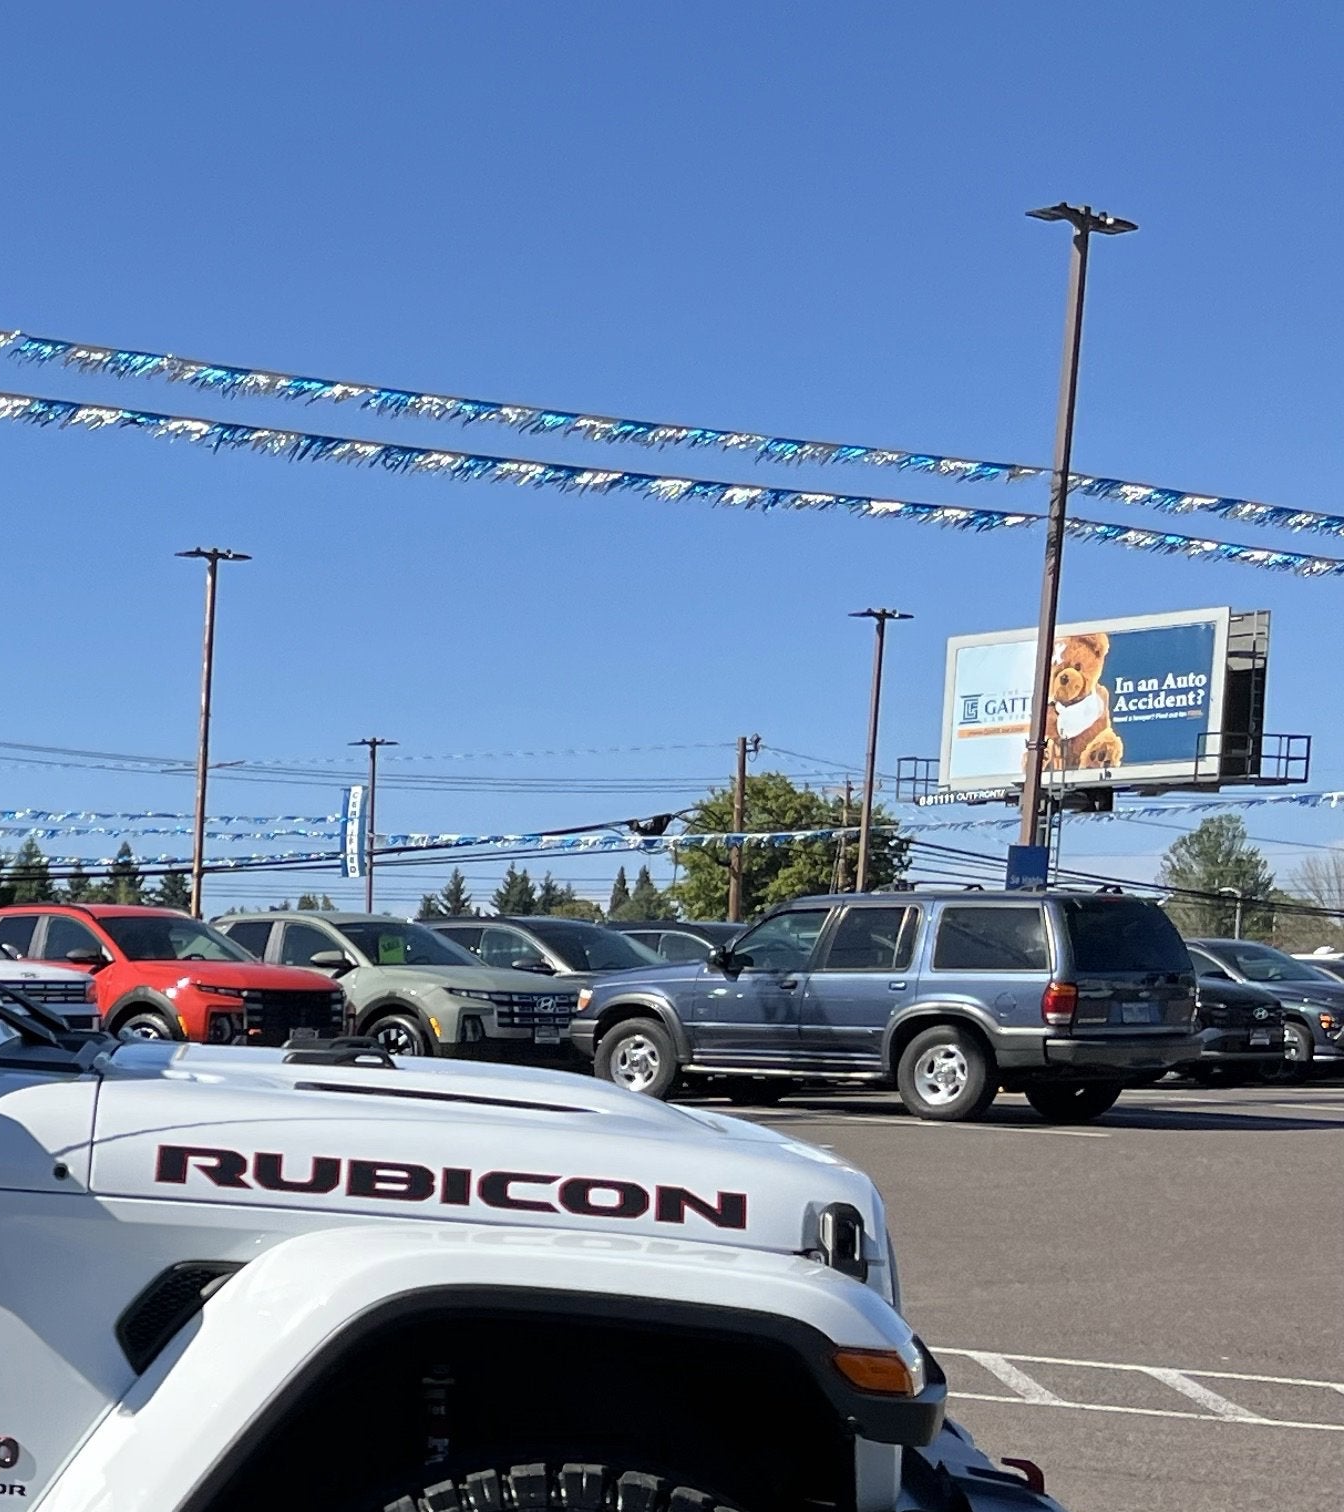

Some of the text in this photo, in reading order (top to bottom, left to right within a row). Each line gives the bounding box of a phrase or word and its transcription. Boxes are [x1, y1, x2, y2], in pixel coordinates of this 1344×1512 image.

[1114, 672, 1207, 694] In an Auto
[984, 697, 1030, 715] GATT
[1113, 689, 1205, 712] Accident?
[155, 1144, 747, 1230] RUBICON
